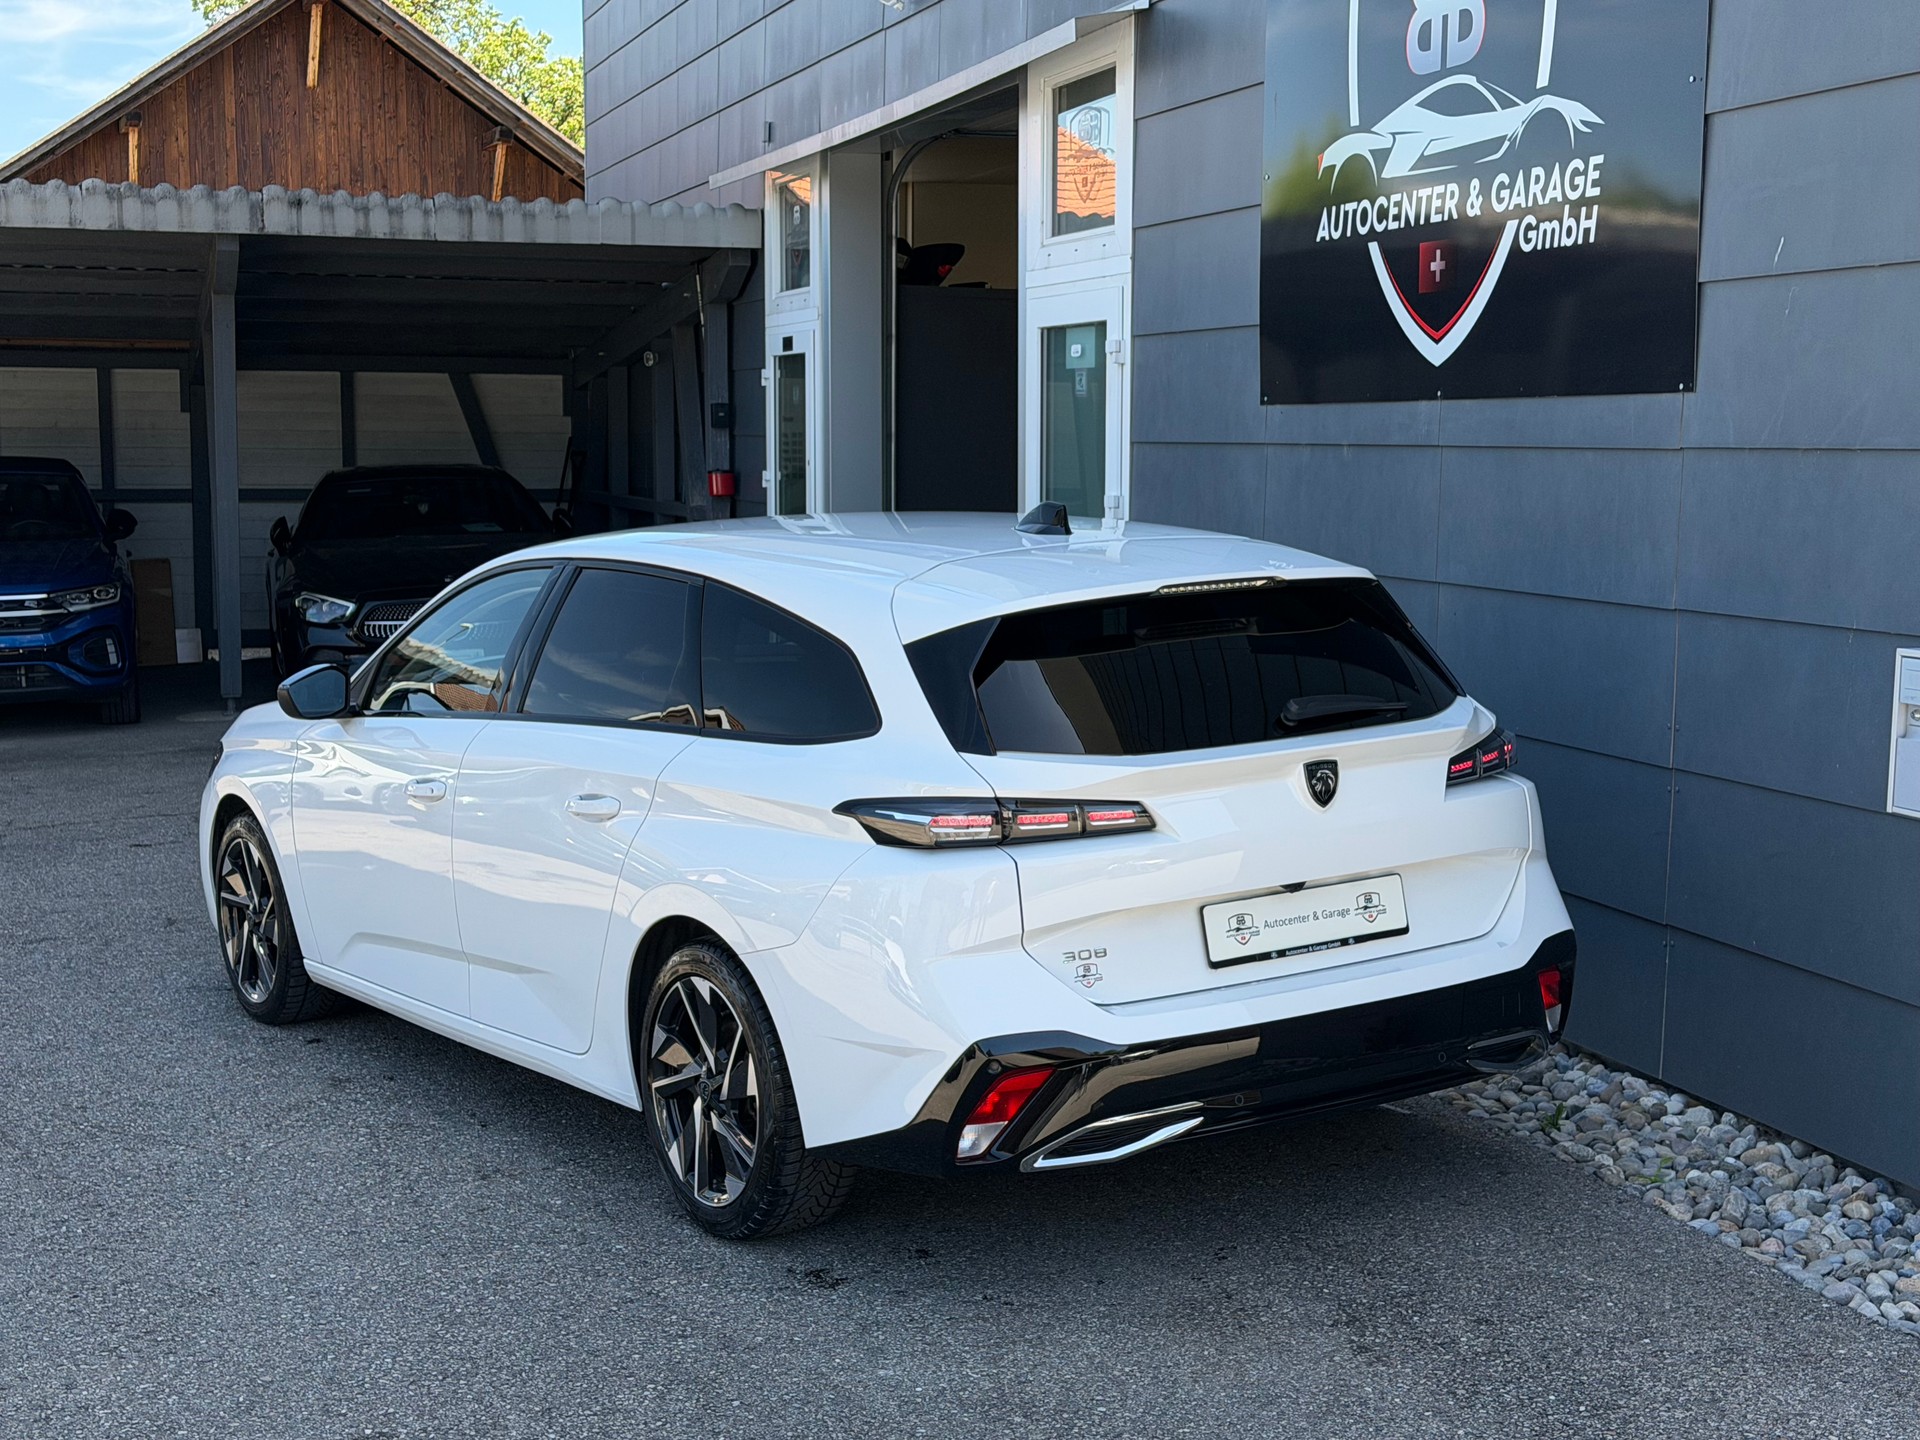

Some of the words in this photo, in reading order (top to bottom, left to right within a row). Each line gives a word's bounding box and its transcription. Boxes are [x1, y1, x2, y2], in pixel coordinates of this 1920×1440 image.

[1316, 183, 1460, 242] AUTOCENTER
[1466, 178, 1483, 217] &
[1491, 154, 1605, 213] GARAGE
[1518, 204, 1599, 252] GmbH
[1263, 914, 1310, 930] Autocenter
[1312, 911, 1320, 921] &
[1321, 907, 1351, 919] Garage
[1062, 948, 1107, 962] 308
